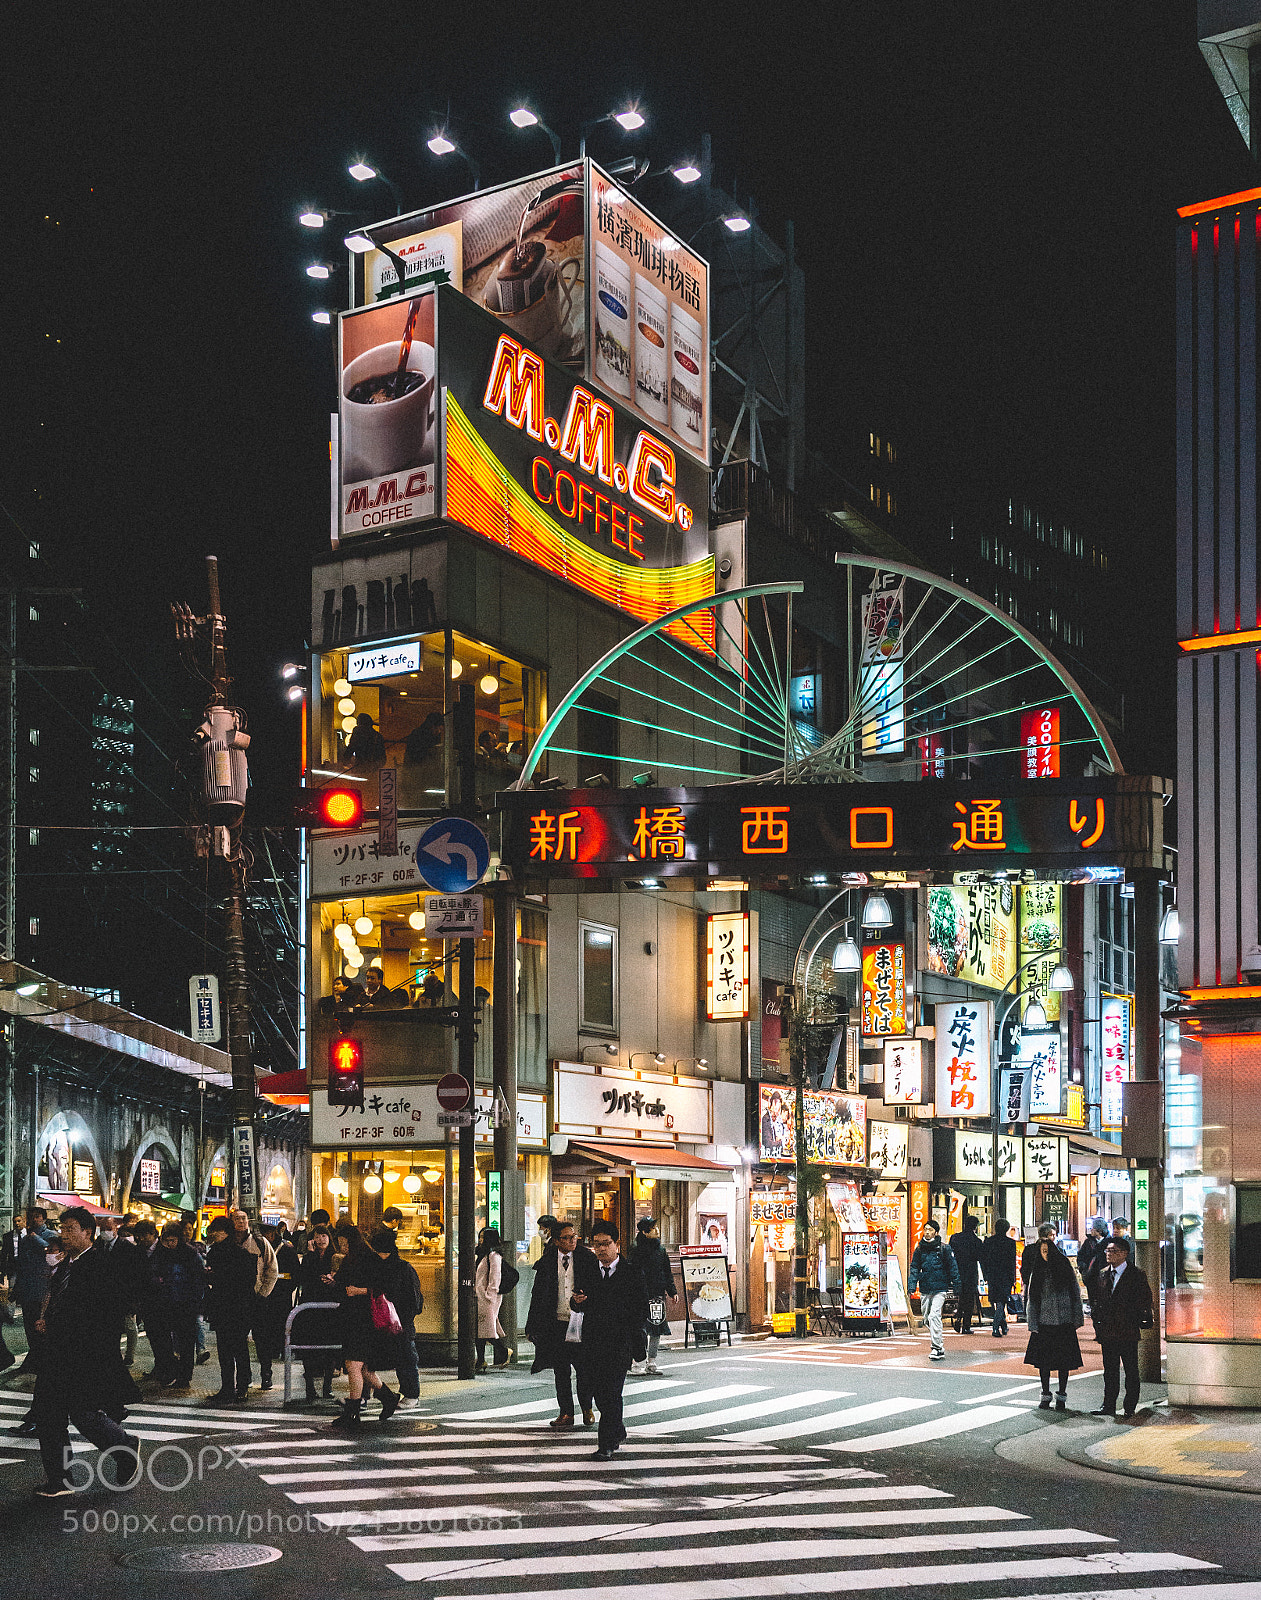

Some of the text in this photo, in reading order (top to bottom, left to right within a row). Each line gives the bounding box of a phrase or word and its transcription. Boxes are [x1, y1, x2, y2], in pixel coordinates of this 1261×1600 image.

[381, 254, 446, 284] 横珈琲物語
[597, 197, 700, 312] 横濱珈琲物語
[362, 502, 413, 527] COFFEE
[531, 455, 646, 561] COFFEE
[529, 798, 1107, 861] 新橋西口通り
[429, 910, 479, 923] 一方通行
[718, 930, 736, 987] ツバキ
[716, 991, 738, 1002] cafe
[873, 947, 893, 1033] まぜそば
[199, 998, 211, 1029] セキネ
[947, 1006, 977, 1111] 炭火焼肉
[804, 1124, 837, 1159] ぜそば
[240, 1158, 251, 1194] セキネ
[1030, 1152, 1054, 1181] 北斗
[752, 1203, 797, 1220] まぜそば
[1045, 1193, 1068, 1203] BAR
[1136, 1179, 1148, 1231] 共栄会
